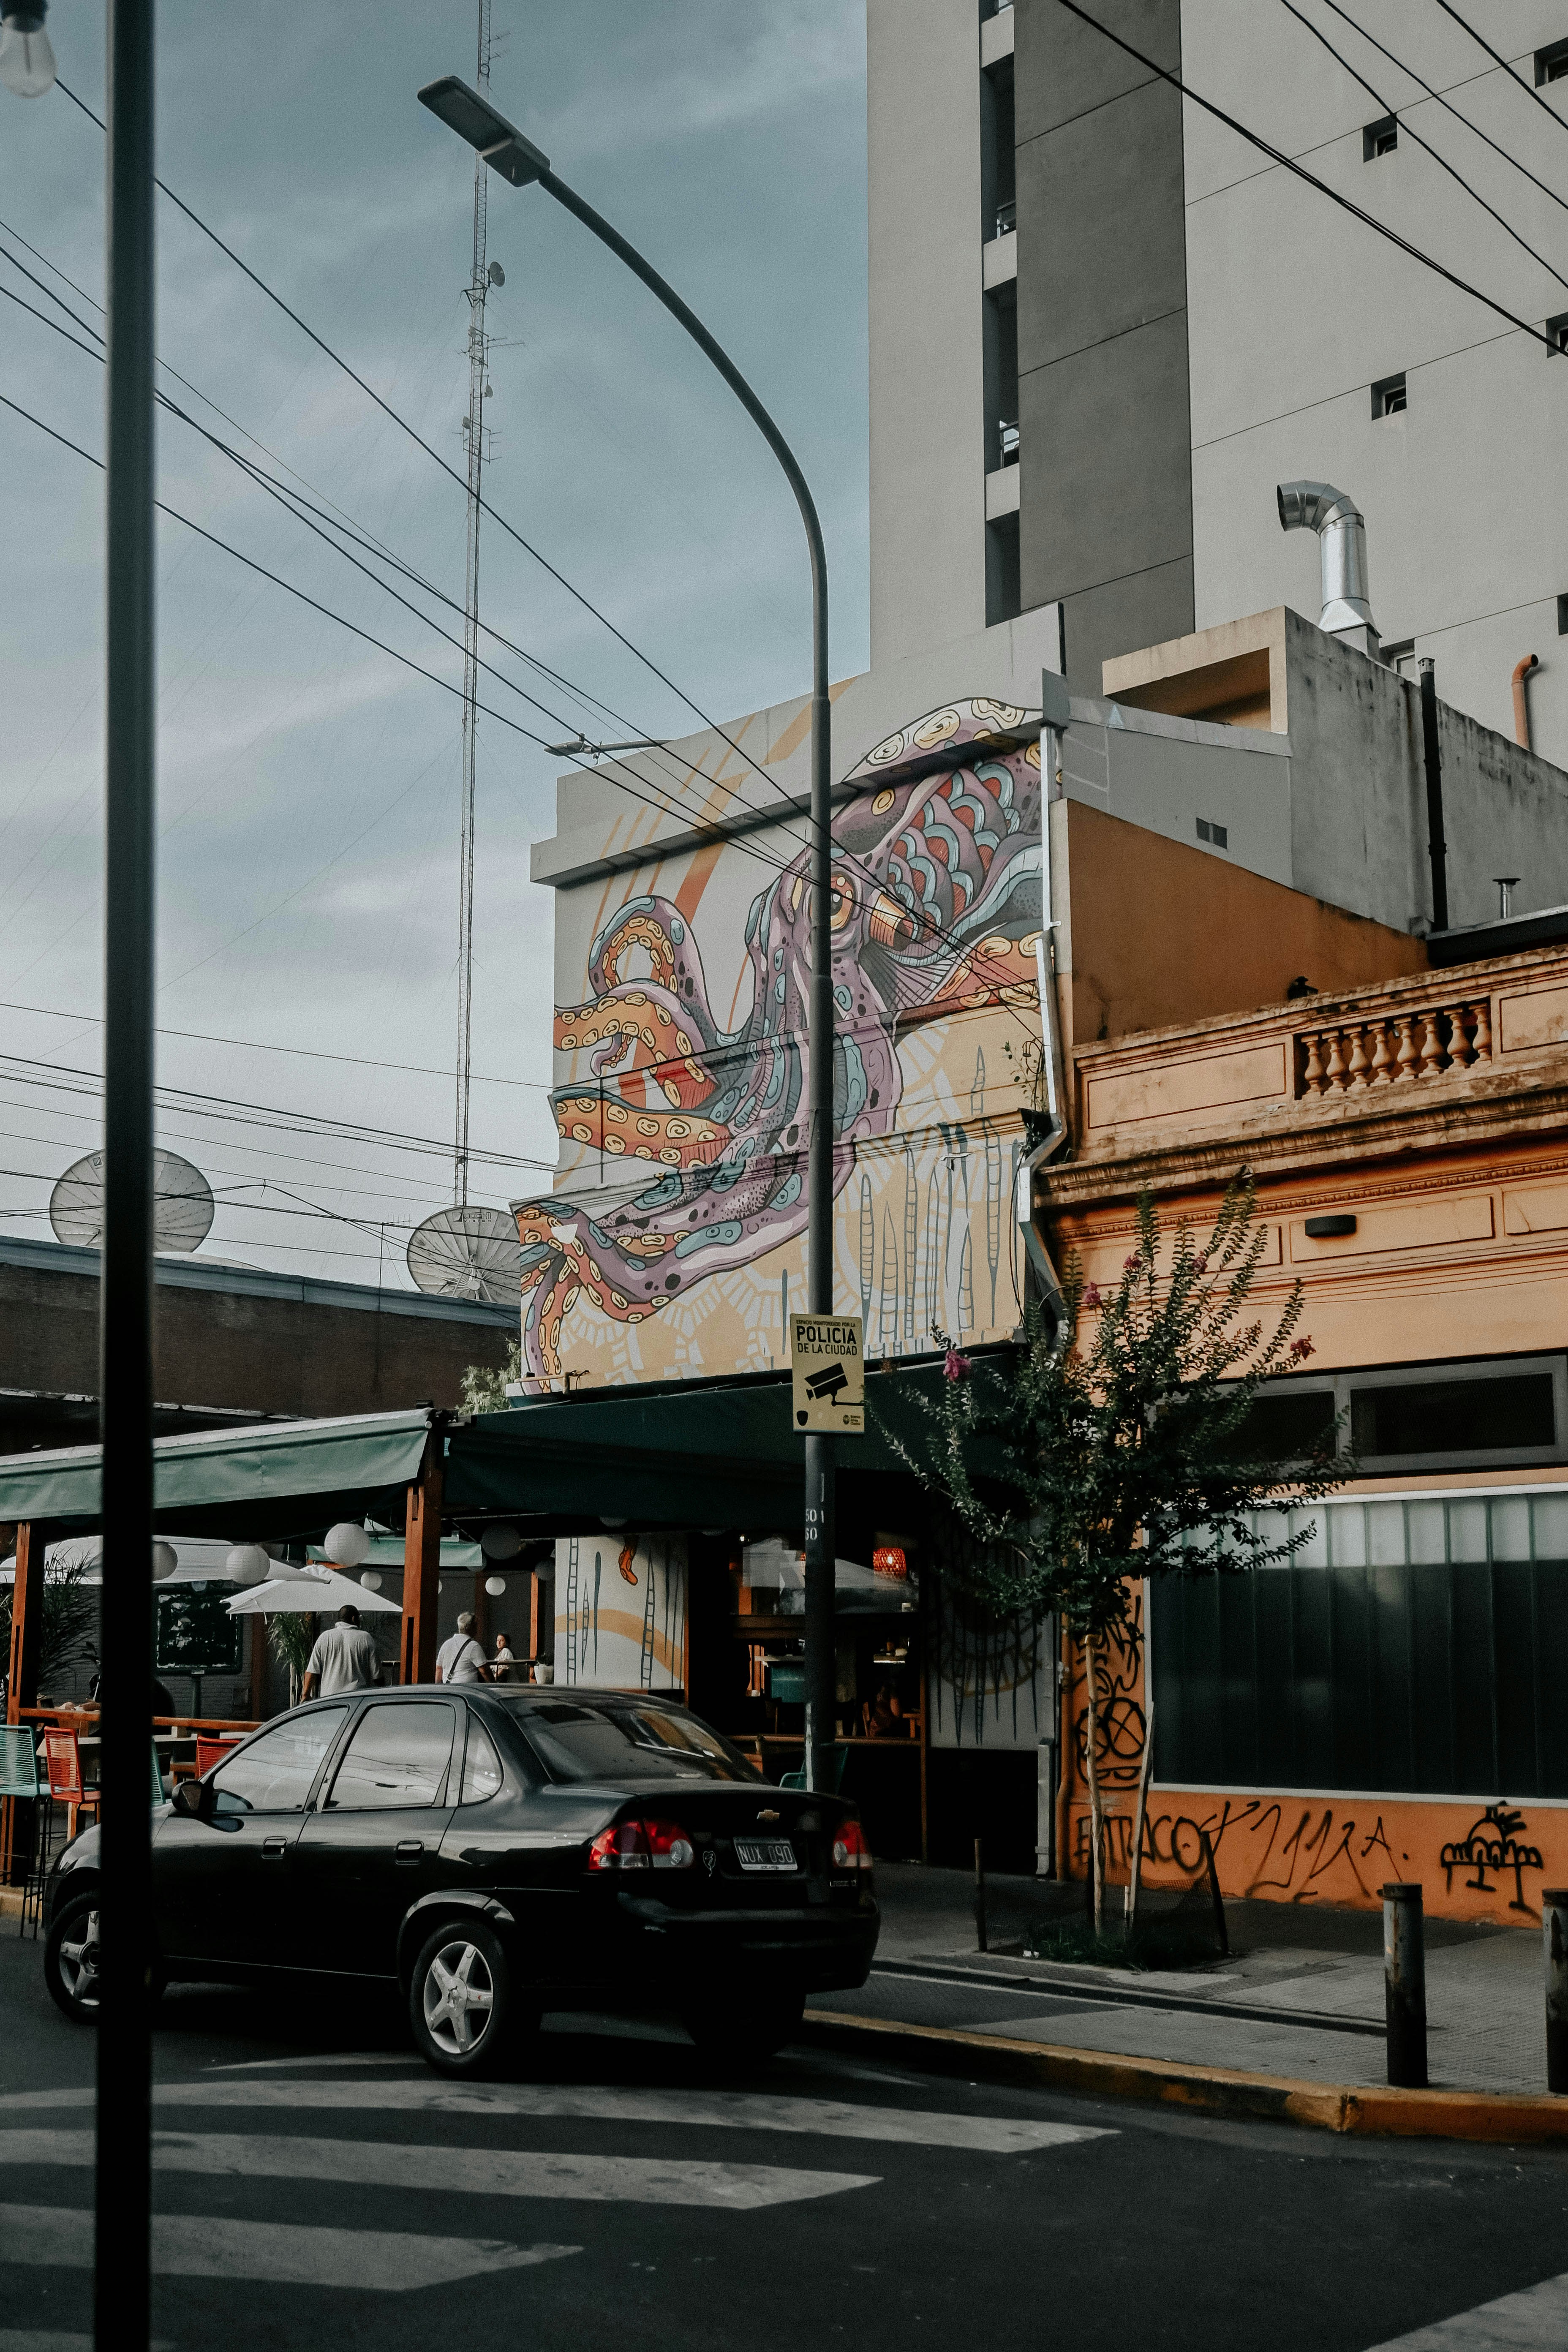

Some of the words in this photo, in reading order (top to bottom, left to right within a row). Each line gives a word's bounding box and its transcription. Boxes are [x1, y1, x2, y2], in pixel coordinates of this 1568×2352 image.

[796, 1325, 857, 1345] POLICIA
[798, 1342, 809, 1353] DE
[812, 1343, 823, 1353] LA
[825, 1344, 858, 1356] CIUDAD
[738, 1845, 763, 1862] NUX
[768, 1845, 793, 1863] 090
